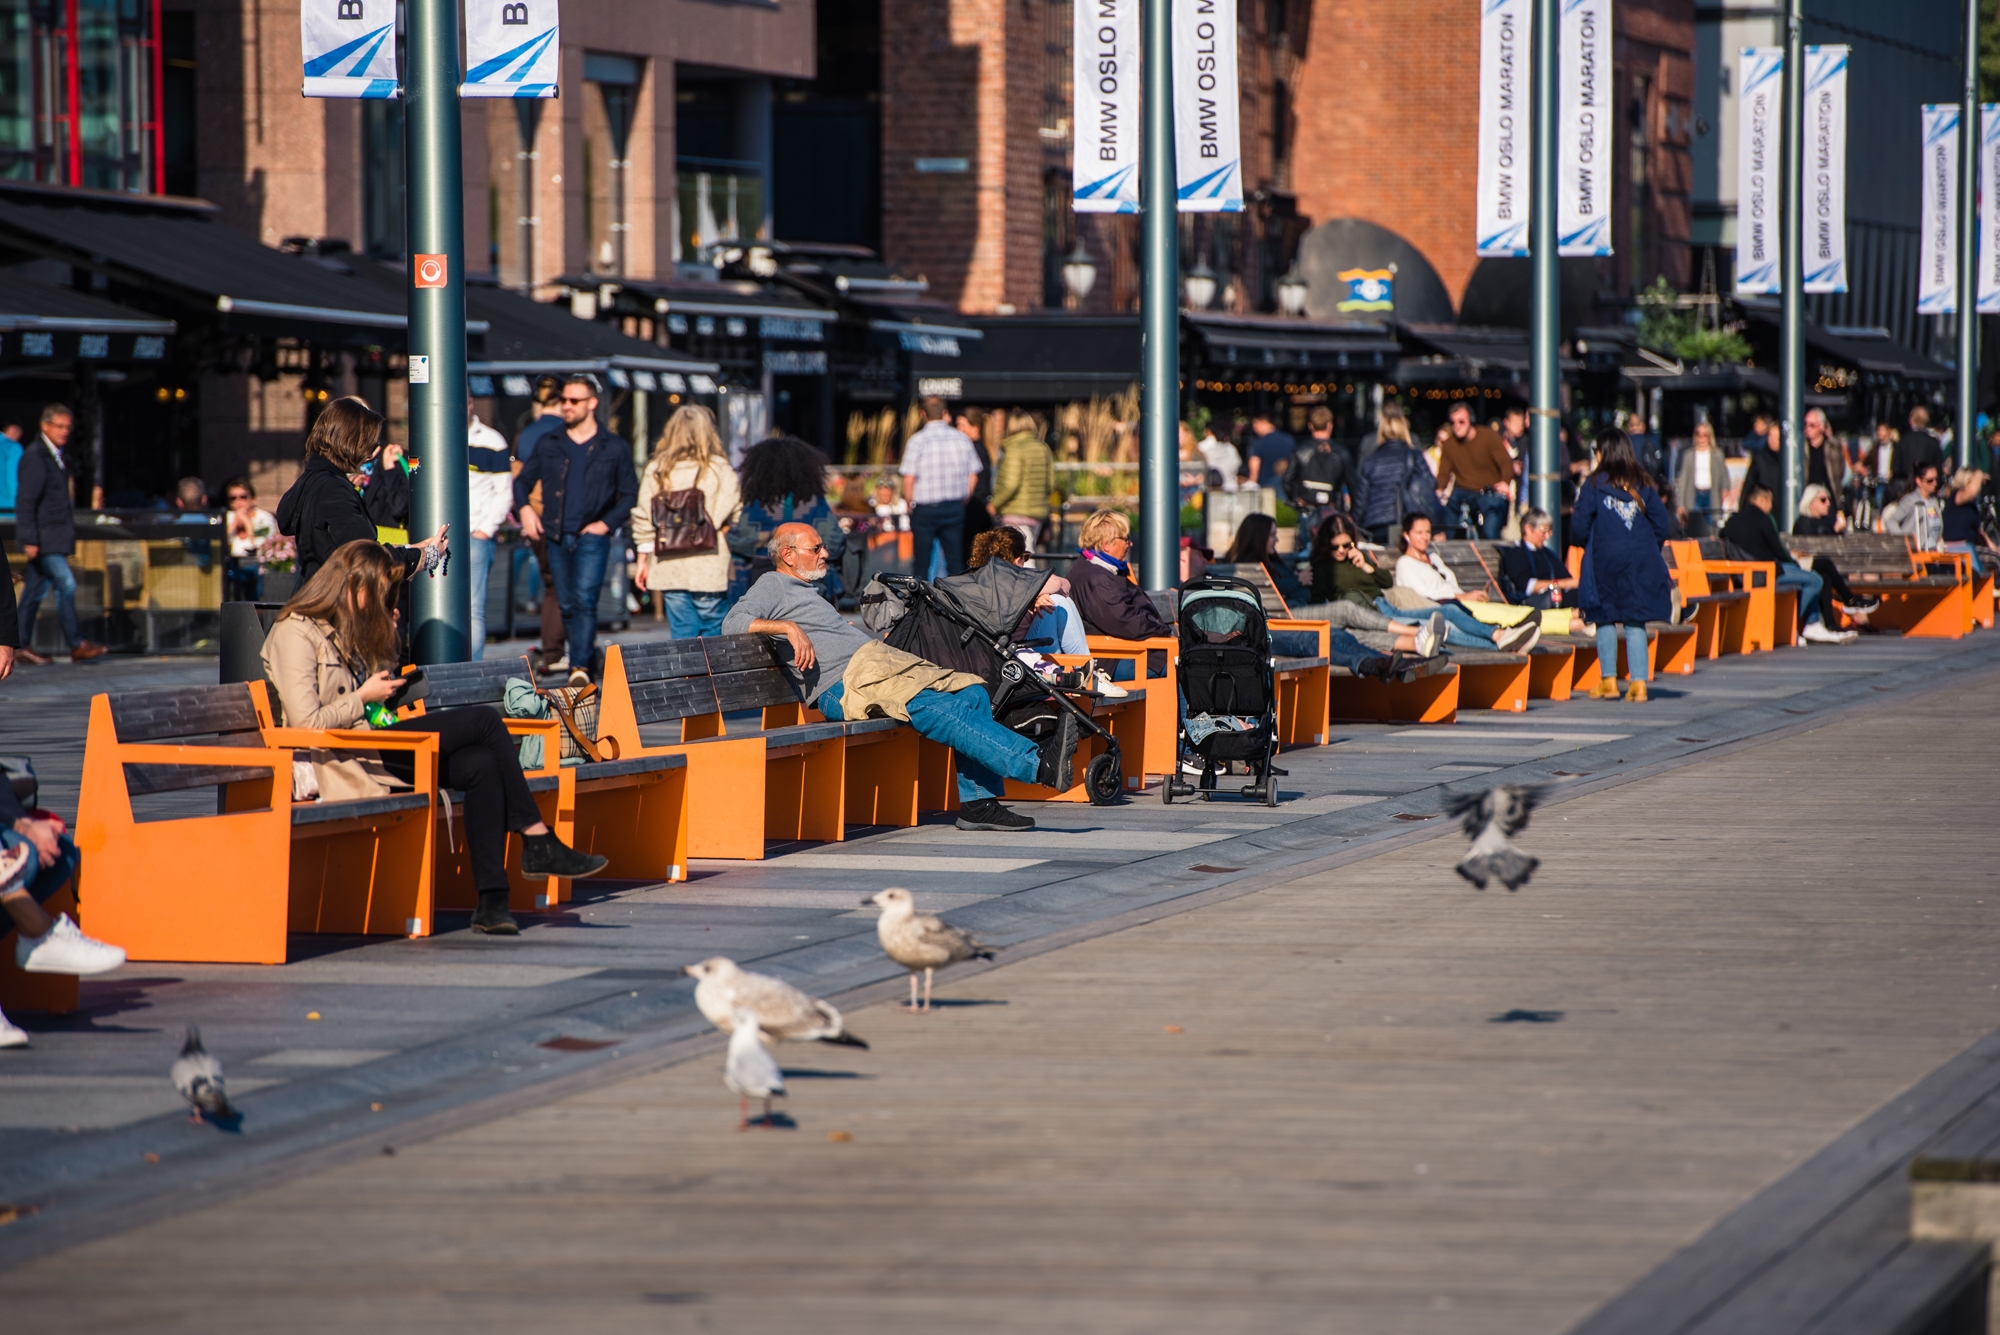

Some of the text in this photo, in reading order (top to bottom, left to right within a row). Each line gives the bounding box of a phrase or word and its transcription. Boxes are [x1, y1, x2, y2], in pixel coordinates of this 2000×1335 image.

[1099, 26, 1117, 94] OSLO
[1198, 22, 1216, 91] OSLO
[1579, 10, 1595, 216] BMW OSLO MARATON
[1100, 101, 1117, 161] BMW
[1199, 98, 1218, 158] BMW
[1498, 13, 1514, 220] BMW OSLO MARATON
[1817, 91, 1832, 260] BMW OSLO MARATON
[1752, 93, 1766, 261] BMW OSLO MARATON
